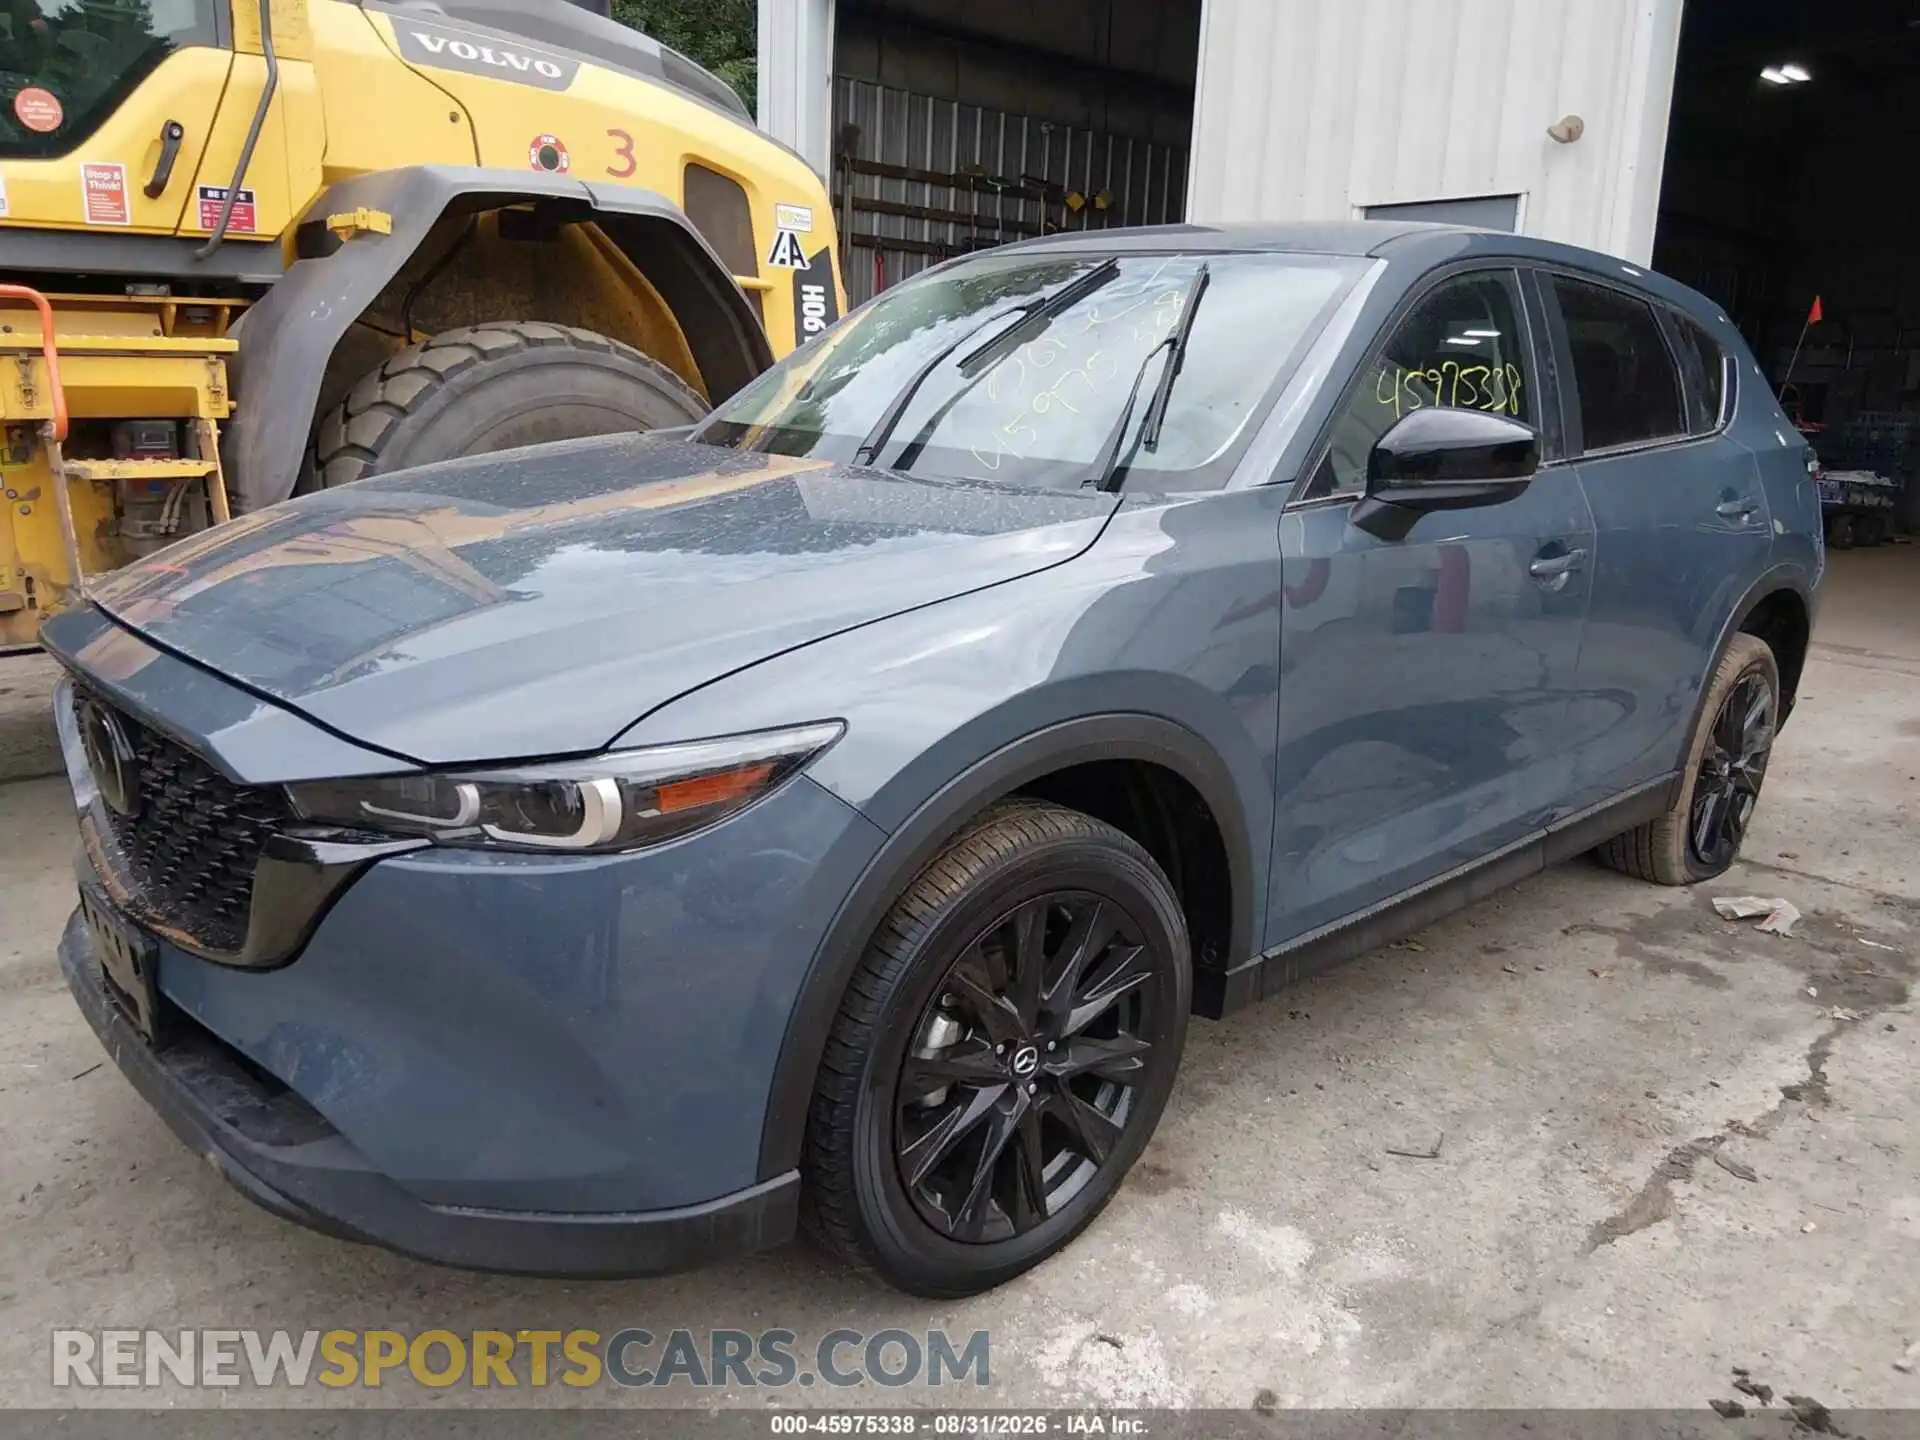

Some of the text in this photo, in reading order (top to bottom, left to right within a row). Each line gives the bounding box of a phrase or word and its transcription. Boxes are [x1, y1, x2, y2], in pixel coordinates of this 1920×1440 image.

[410, 31, 562, 79] VOLVO
[605, 129, 638, 178] 3
[801, 284, 826, 343] 90H
[1375, 360, 1522, 419] 45975338
